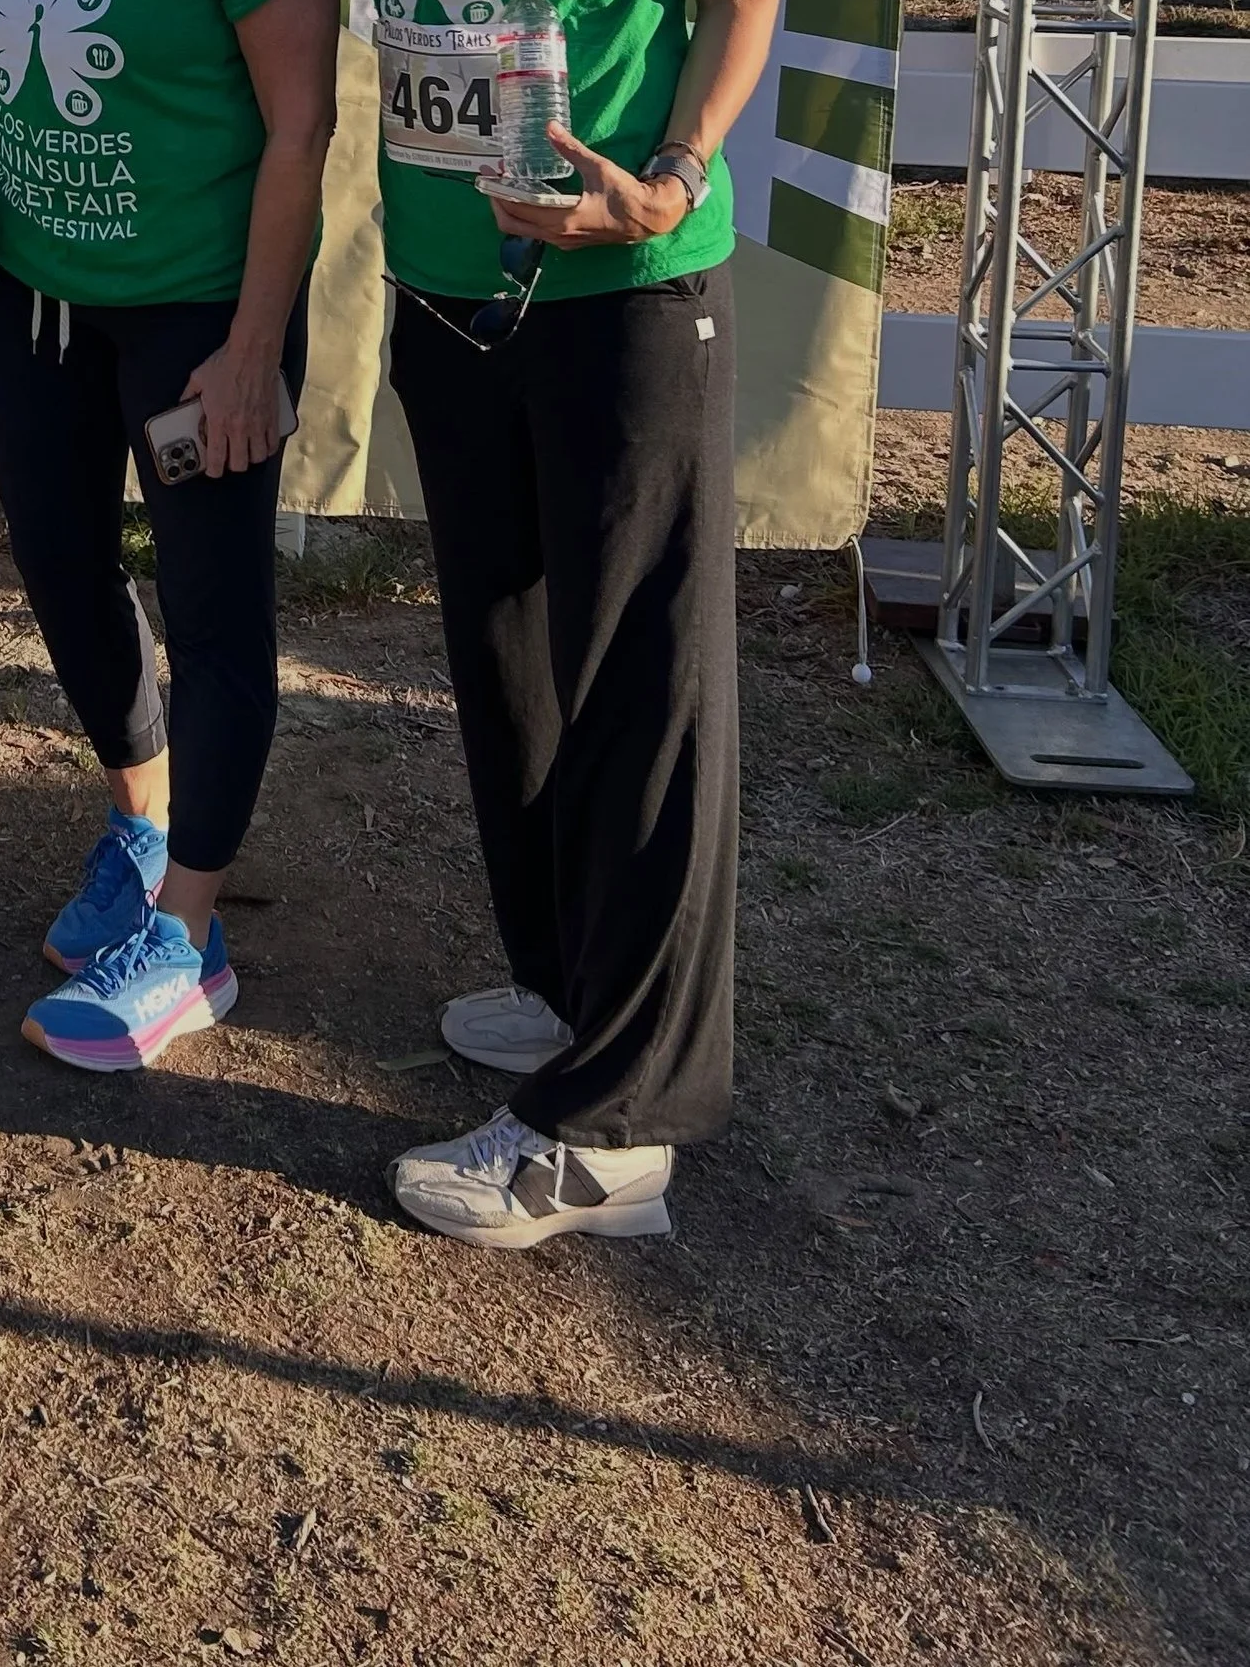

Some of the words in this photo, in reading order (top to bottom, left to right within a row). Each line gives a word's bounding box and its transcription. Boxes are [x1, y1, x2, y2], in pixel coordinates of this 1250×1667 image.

[404, 27, 442, 47] VERDES
[446, 29, 492, 50] TRAILS
[392, 72, 497, 136] 464
[29, 125, 133, 156] VERDES
[65, 191, 138, 216] FAIR
[41, 215, 138, 241] FESTIVAL
[134, 972, 191, 1024] HOKA
